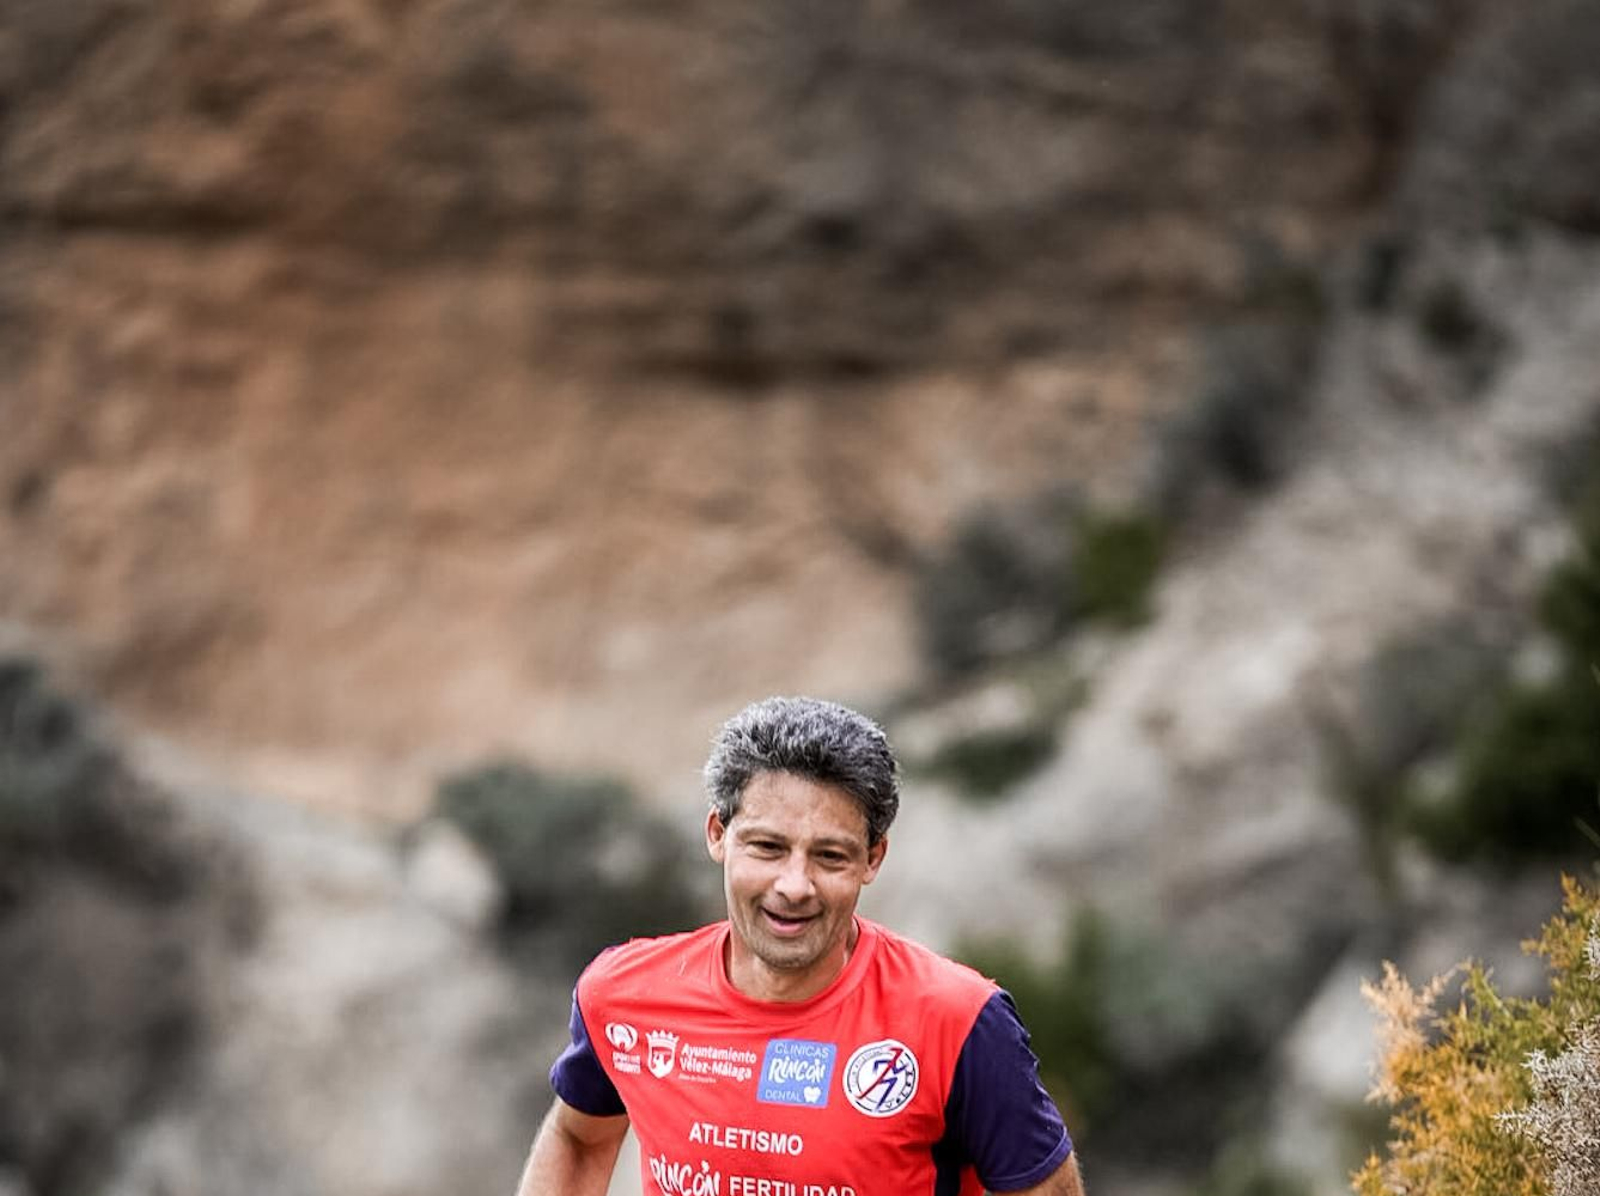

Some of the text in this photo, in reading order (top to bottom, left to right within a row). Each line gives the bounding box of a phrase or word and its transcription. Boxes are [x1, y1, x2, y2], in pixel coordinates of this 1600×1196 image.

[681, 1043, 757, 1064] Ayuntamiento
[765, 1088, 801, 1102] DENTAL
[689, 1122, 803, 1155] ATLETISMO
